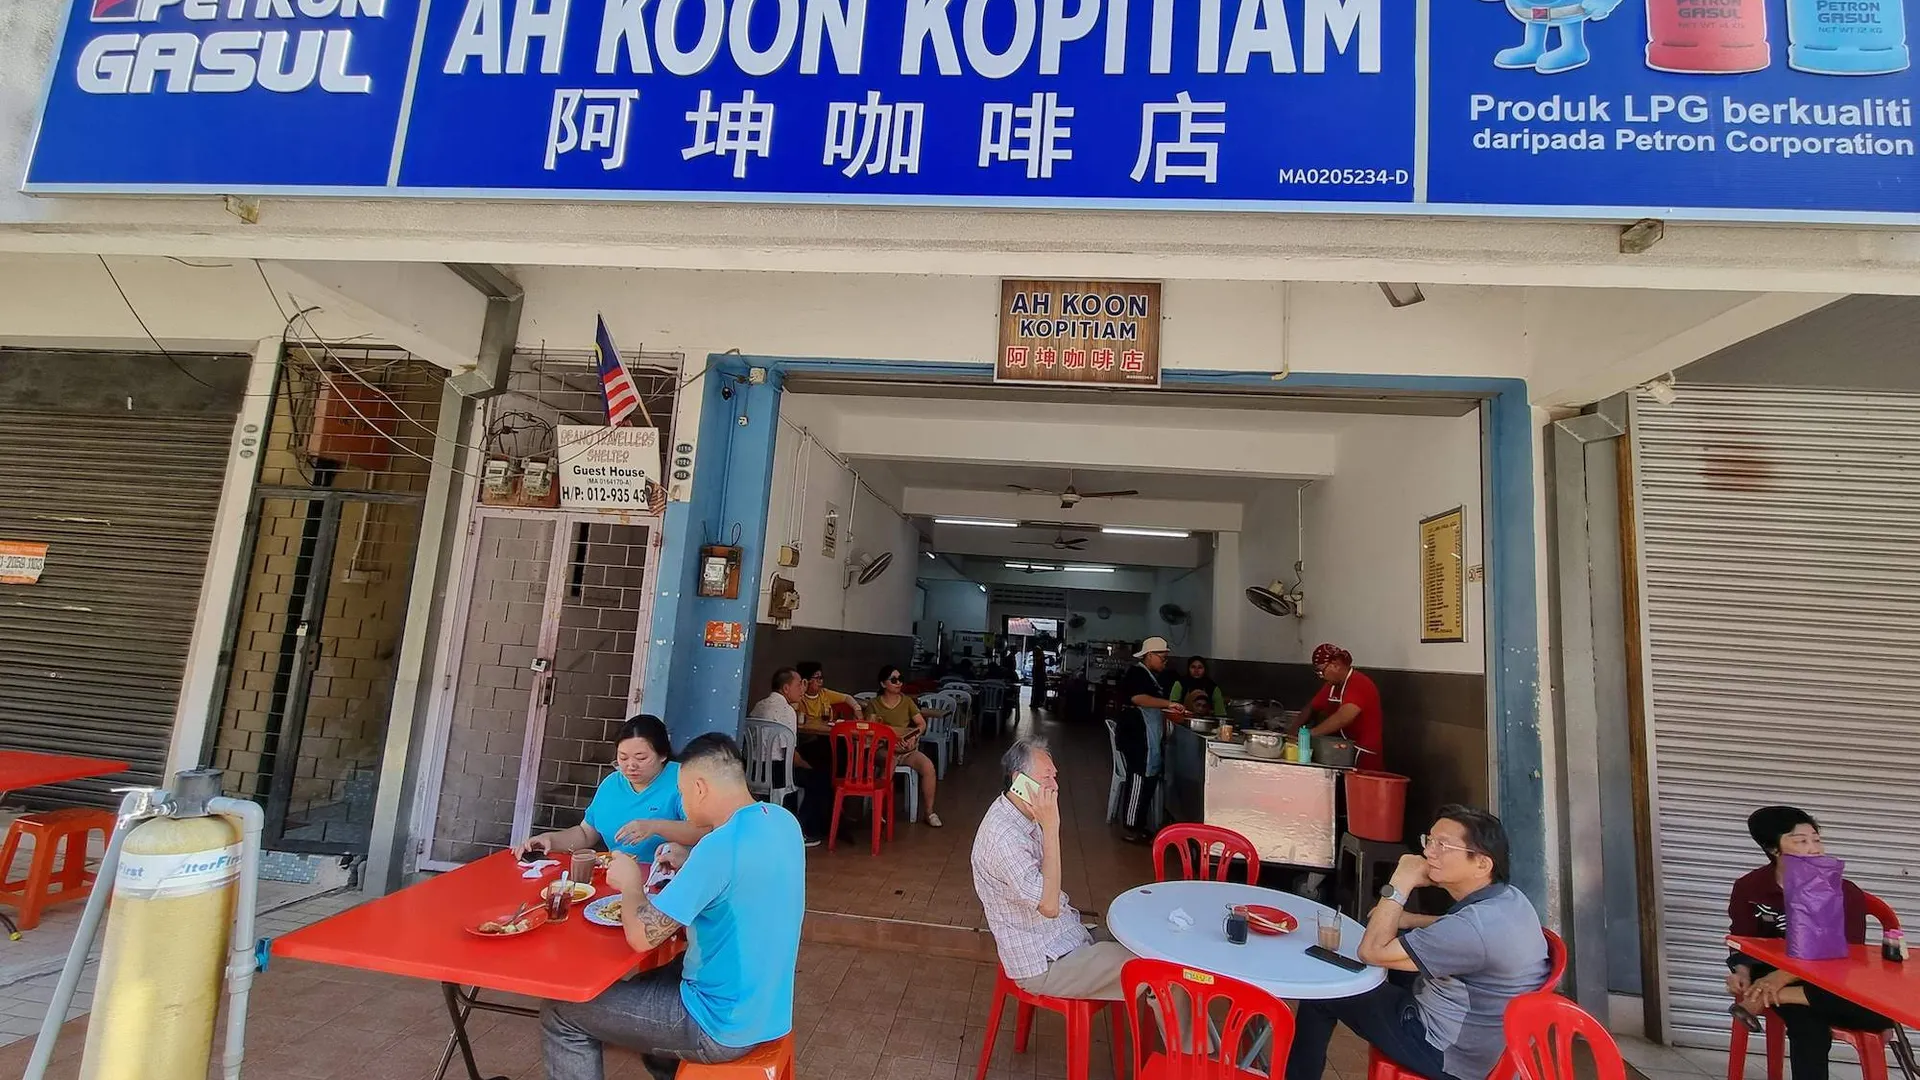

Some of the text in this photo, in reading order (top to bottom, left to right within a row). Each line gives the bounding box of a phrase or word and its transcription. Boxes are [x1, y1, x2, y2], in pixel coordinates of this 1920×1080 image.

[1678, 7, 1742, 19] GASUL
[1817, 0, 1880, 11] PETRON
[1818, 13, 1881, 24] GASUL
[443, 0, 1382, 79] AH KOON KOPITIAM
[77, 30, 372, 94] GASUL
[1470, 94, 1912, 127] Produk LPG berkualiti
[544, 88, 1227, 184] 阿坤咖啡店
[1473, 128, 1914, 158] daripada Petron Corporation
[1279, 168, 1409, 185] MA0205234-D
[1011, 293, 1148, 318] AH KOON
[1020, 319, 1137, 341] KOPITIAM
[1006, 346, 1144, 372] 阿坤咖啡店
[587, 449, 629, 463] SHELTER
[573, 465, 645, 477] Guest House
[562, 486, 584, 501] H/P:
[587, 487, 630, 502] 012-935
